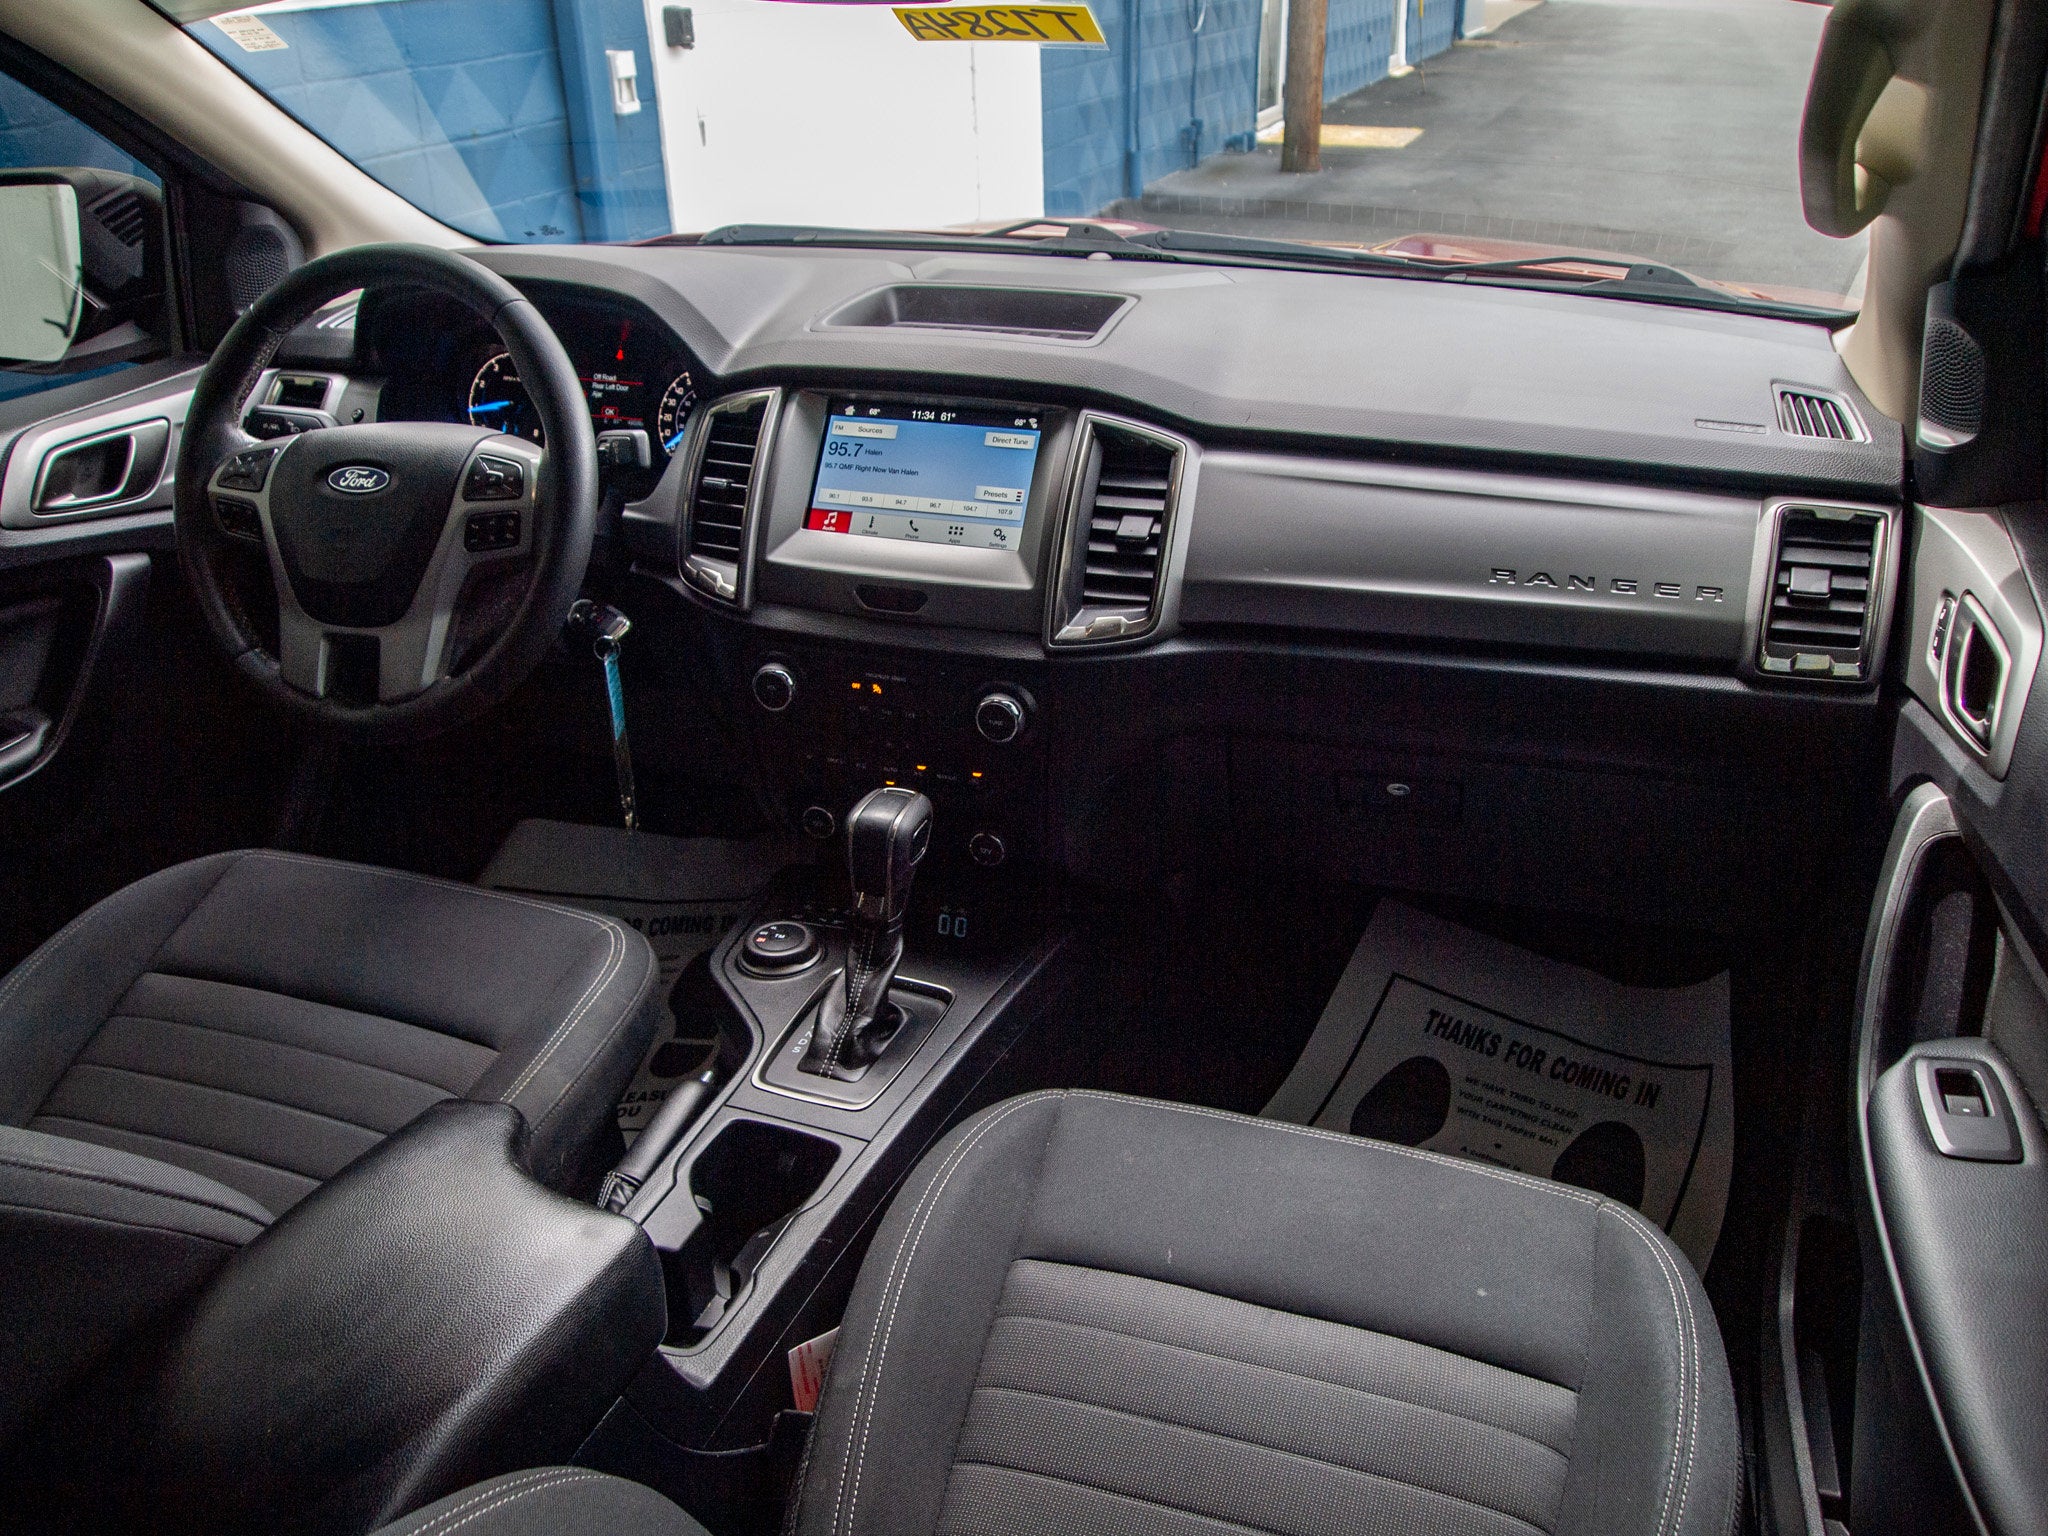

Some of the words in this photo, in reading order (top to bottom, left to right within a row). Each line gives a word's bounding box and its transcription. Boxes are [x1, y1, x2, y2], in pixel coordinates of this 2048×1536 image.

[912, 409, 935, 421] 11:34
[858, 426, 883, 434] Sources
[828, 441, 864, 458] 95.7
[992, 436, 1011, 445] Direct
[1013, 437, 1028, 445] Tune
[339, 469, 377, 488] Ford
[855, 464, 872, 474] Right
[872, 466, 887, 474] Now
[888, 467, 899, 475] Van
[983, 490, 1008, 499] Presets
[1489, 568, 1724, 602] RANGER
[649, 915, 715, 936] COMING
[1424, 1009, 1502, 1057] THANKS
[1503, 1040, 1546, 1074] FOR
[1550, 1056, 1630, 1100] COMING
[1635, 1080, 1662, 1108] IN
[1465, 1075, 1479, 1086] WE
[1481, 1080, 1506, 1096] HAVE
[1510, 1089, 1536, 1106] TRIED
[1539, 1099, 1552, 1109] TO
[1553, 1105, 1579, 1119] KEEP
[1458, 1089, 1483, 1104] YOUR
[1486, 1099, 1539, 1124] CARPETING
[1540, 1117, 1573, 1134] CLEAN
[1456, 1106, 1480, 1121] WITH
[1481, 1114, 1502, 1128] THIS
[1504, 1122, 1536, 1139] PAPER
